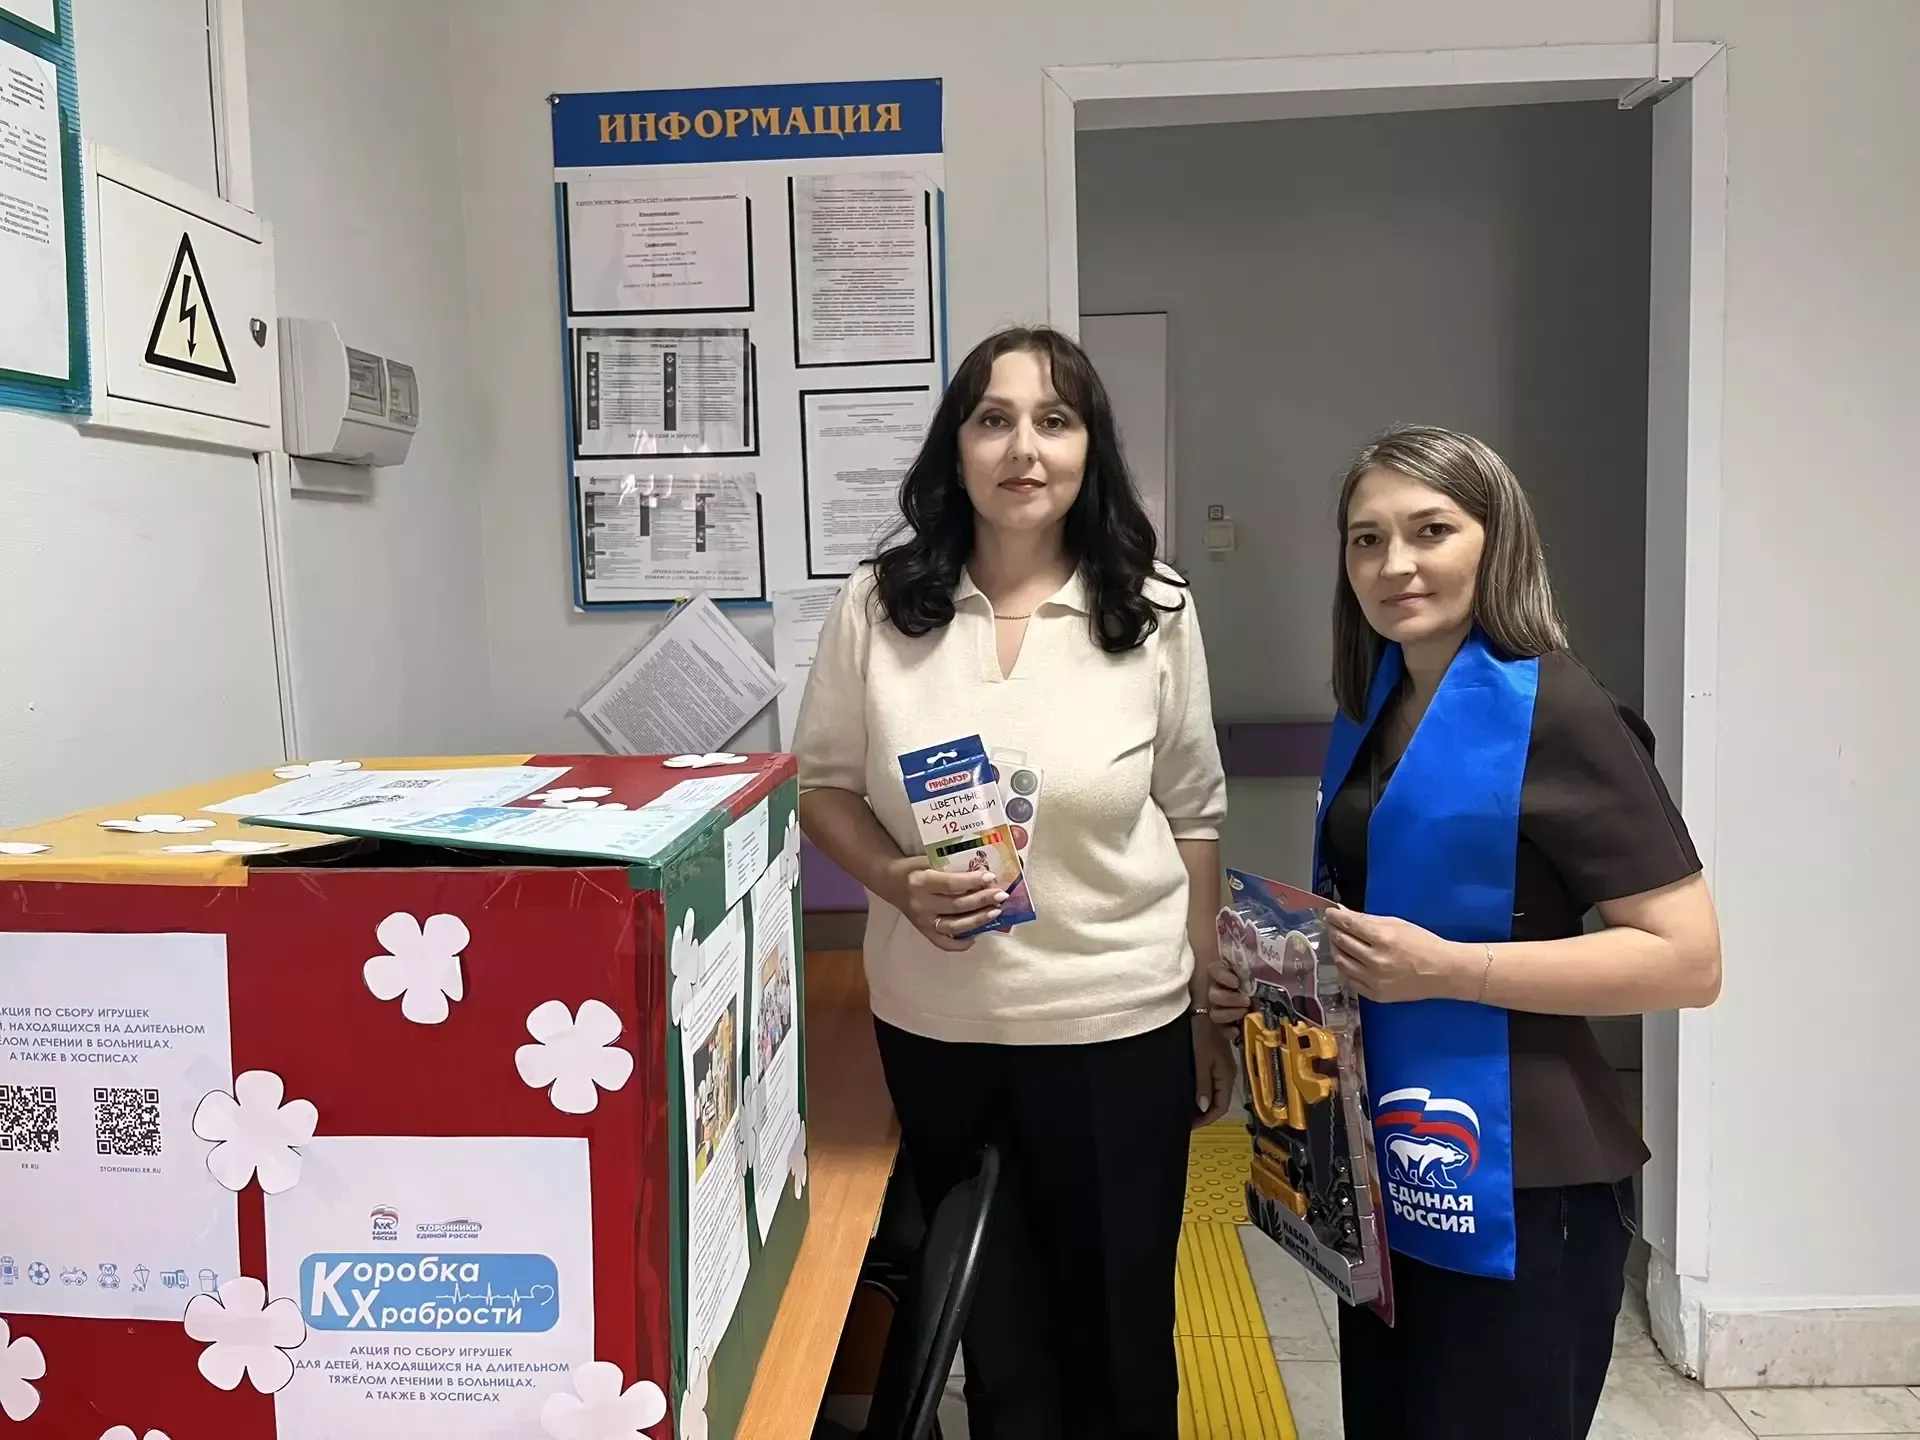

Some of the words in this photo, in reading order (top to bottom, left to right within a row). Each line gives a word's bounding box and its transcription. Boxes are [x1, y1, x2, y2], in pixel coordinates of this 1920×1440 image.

[598, 102, 902, 145] ИНФОРМАЦИЯ
[929, 772, 969, 789] ПИФАГОР
[930, 791, 981, 811] ЦВЕТНЫЕ
[922, 799, 996, 825] КАРАНДАШИ
[942, 821, 959, 834] 12
[35, 1007, 52, 1017] ПО
[56, 1008, 94, 1018] СБОРУ
[98, 1008, 150, 1018] ИГРУШЕК
[9, 1022, 101, 1034] НАХОДЯЩИХСЯ
[104, 1024, 120, 1034] НА
[124, 1024, 205, 1035] ДЛИТЕЛЬНОМ
[32, 1037, 83, 1048] ЛЕЧЕНИИ
[87, 1039, 93, 1048] В
[97, 1038, 173, 1050] БОЛЬНИЦАХ,
[9, 1052, 17, 1061] А
[20, 1052, 57, 1062] ТАКЖЕ
[61, 1053, 67, 1062] В
[71, 1053, 138, 1063] ХОСПИСАХ
[1387, 1181, 1474, 1212] ЕДИНАЯ
[1392, 1199, 1475, 1234] РОССИЯ
[416, 1224, 479, 1232] СТОРОННИКИ
[1282, 1220, 1310, 1248] НАБОР
[1284, 1235, 1352, 1298] ИНСТРУМЕНТОВ
[311, 1257, 480, 1317] Коробка
[346, 1288, 523, 1330] Храбрости
[350, 1346, 390, 1358] АКЦИЯ
[394, 1346, 411, 1357] ПО
[416, 1346, 454, 1358] СБОРУ
[459, 1347, 513, 1358] ИГРУШЕК
[296, 1359, 321, 1370] ДЛЯ
[325, 1358, 362, 1371] ДЕТЕЙ,
[366, 1360, 462, 1373] НАХОДЯЩИХСЯ
[466, 1361, 482, 1372] НА
[486, 1362, 570, 1373] ДЛИТЕЛЬНОМ
[329, 1373, 387, 1385] ТЯЖЁЛОМ
[391, 1375, 443, 1386] ЛЕЧЕНИИ
[447, 1376, 453, 1386] В
[458, 1375, 536, 1389] БОЛЬНИЦАХ,
[365, 1391, 373, 1400] А
[377, 1390, 416, 1401] ТАКЖЕ
[420, 1391, 426, 1401] В
[430, 1391, 501, 1402] ХОСПИСАХ
